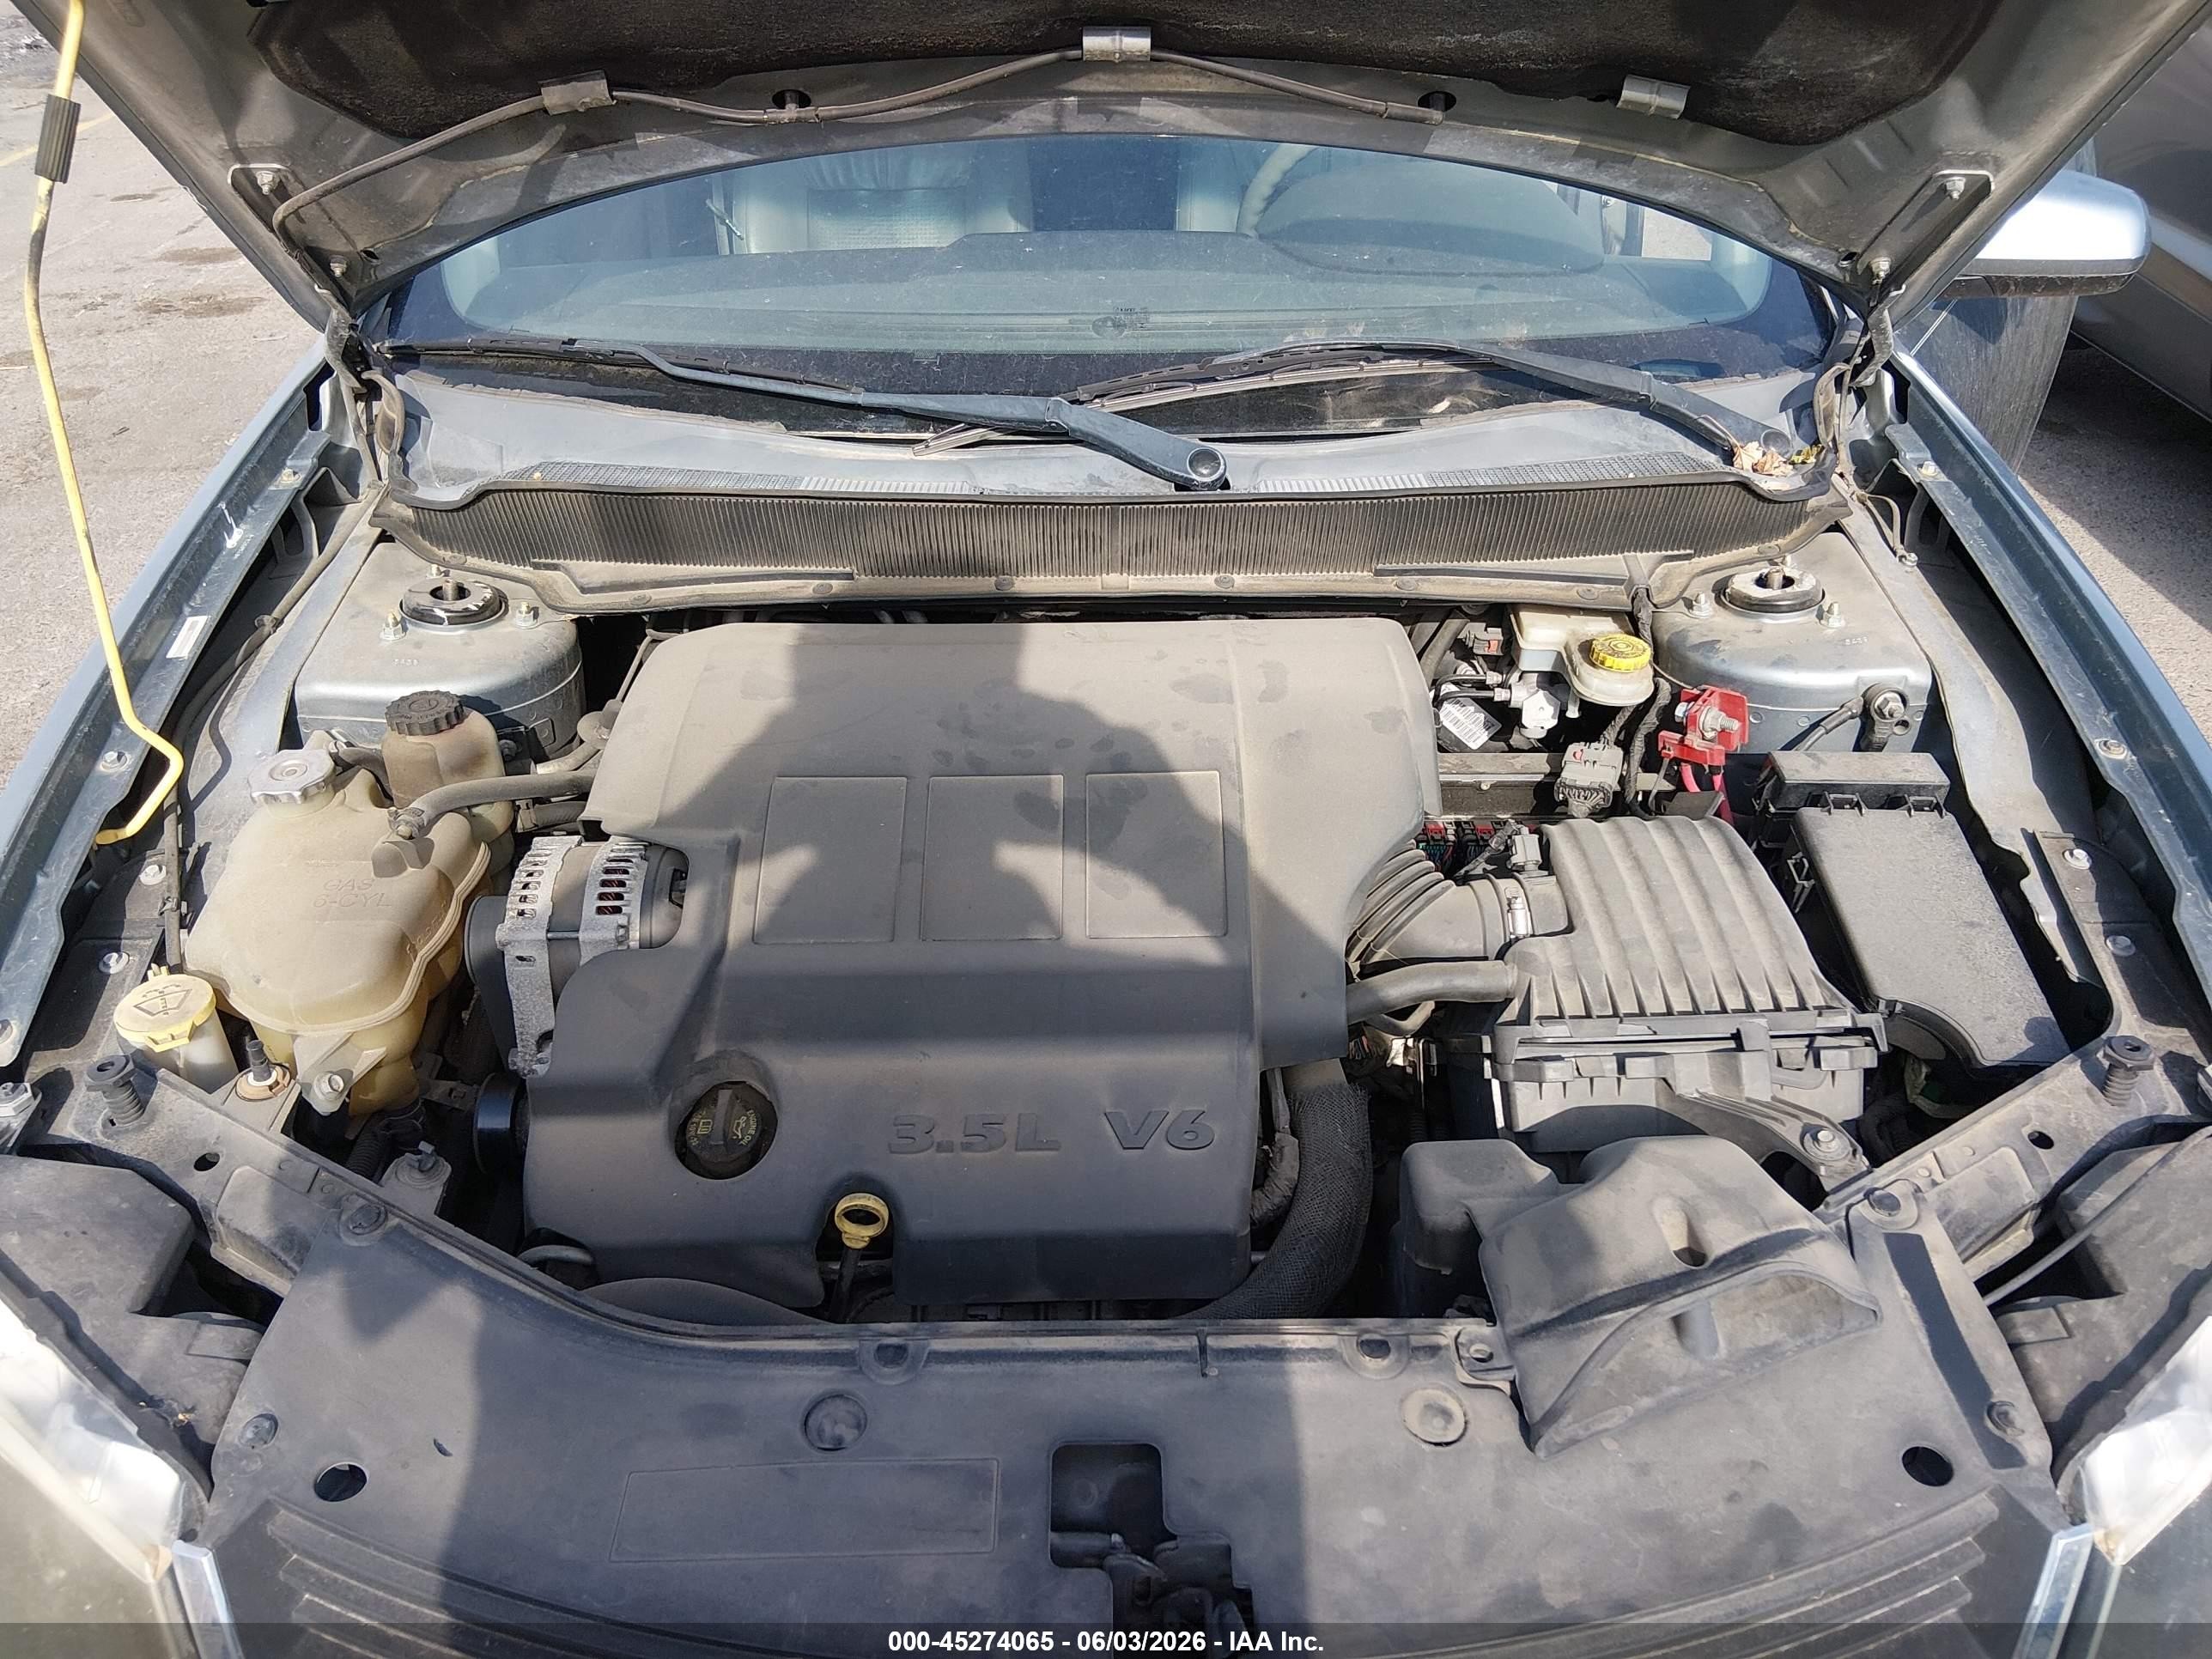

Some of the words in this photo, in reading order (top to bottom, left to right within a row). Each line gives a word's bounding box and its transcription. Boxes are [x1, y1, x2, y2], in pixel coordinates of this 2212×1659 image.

[323, 878, 374, 891] GAS
[887, 1112, 1061, 1155] 3.5L
[1103, 1109, 1215, 1151] V6
